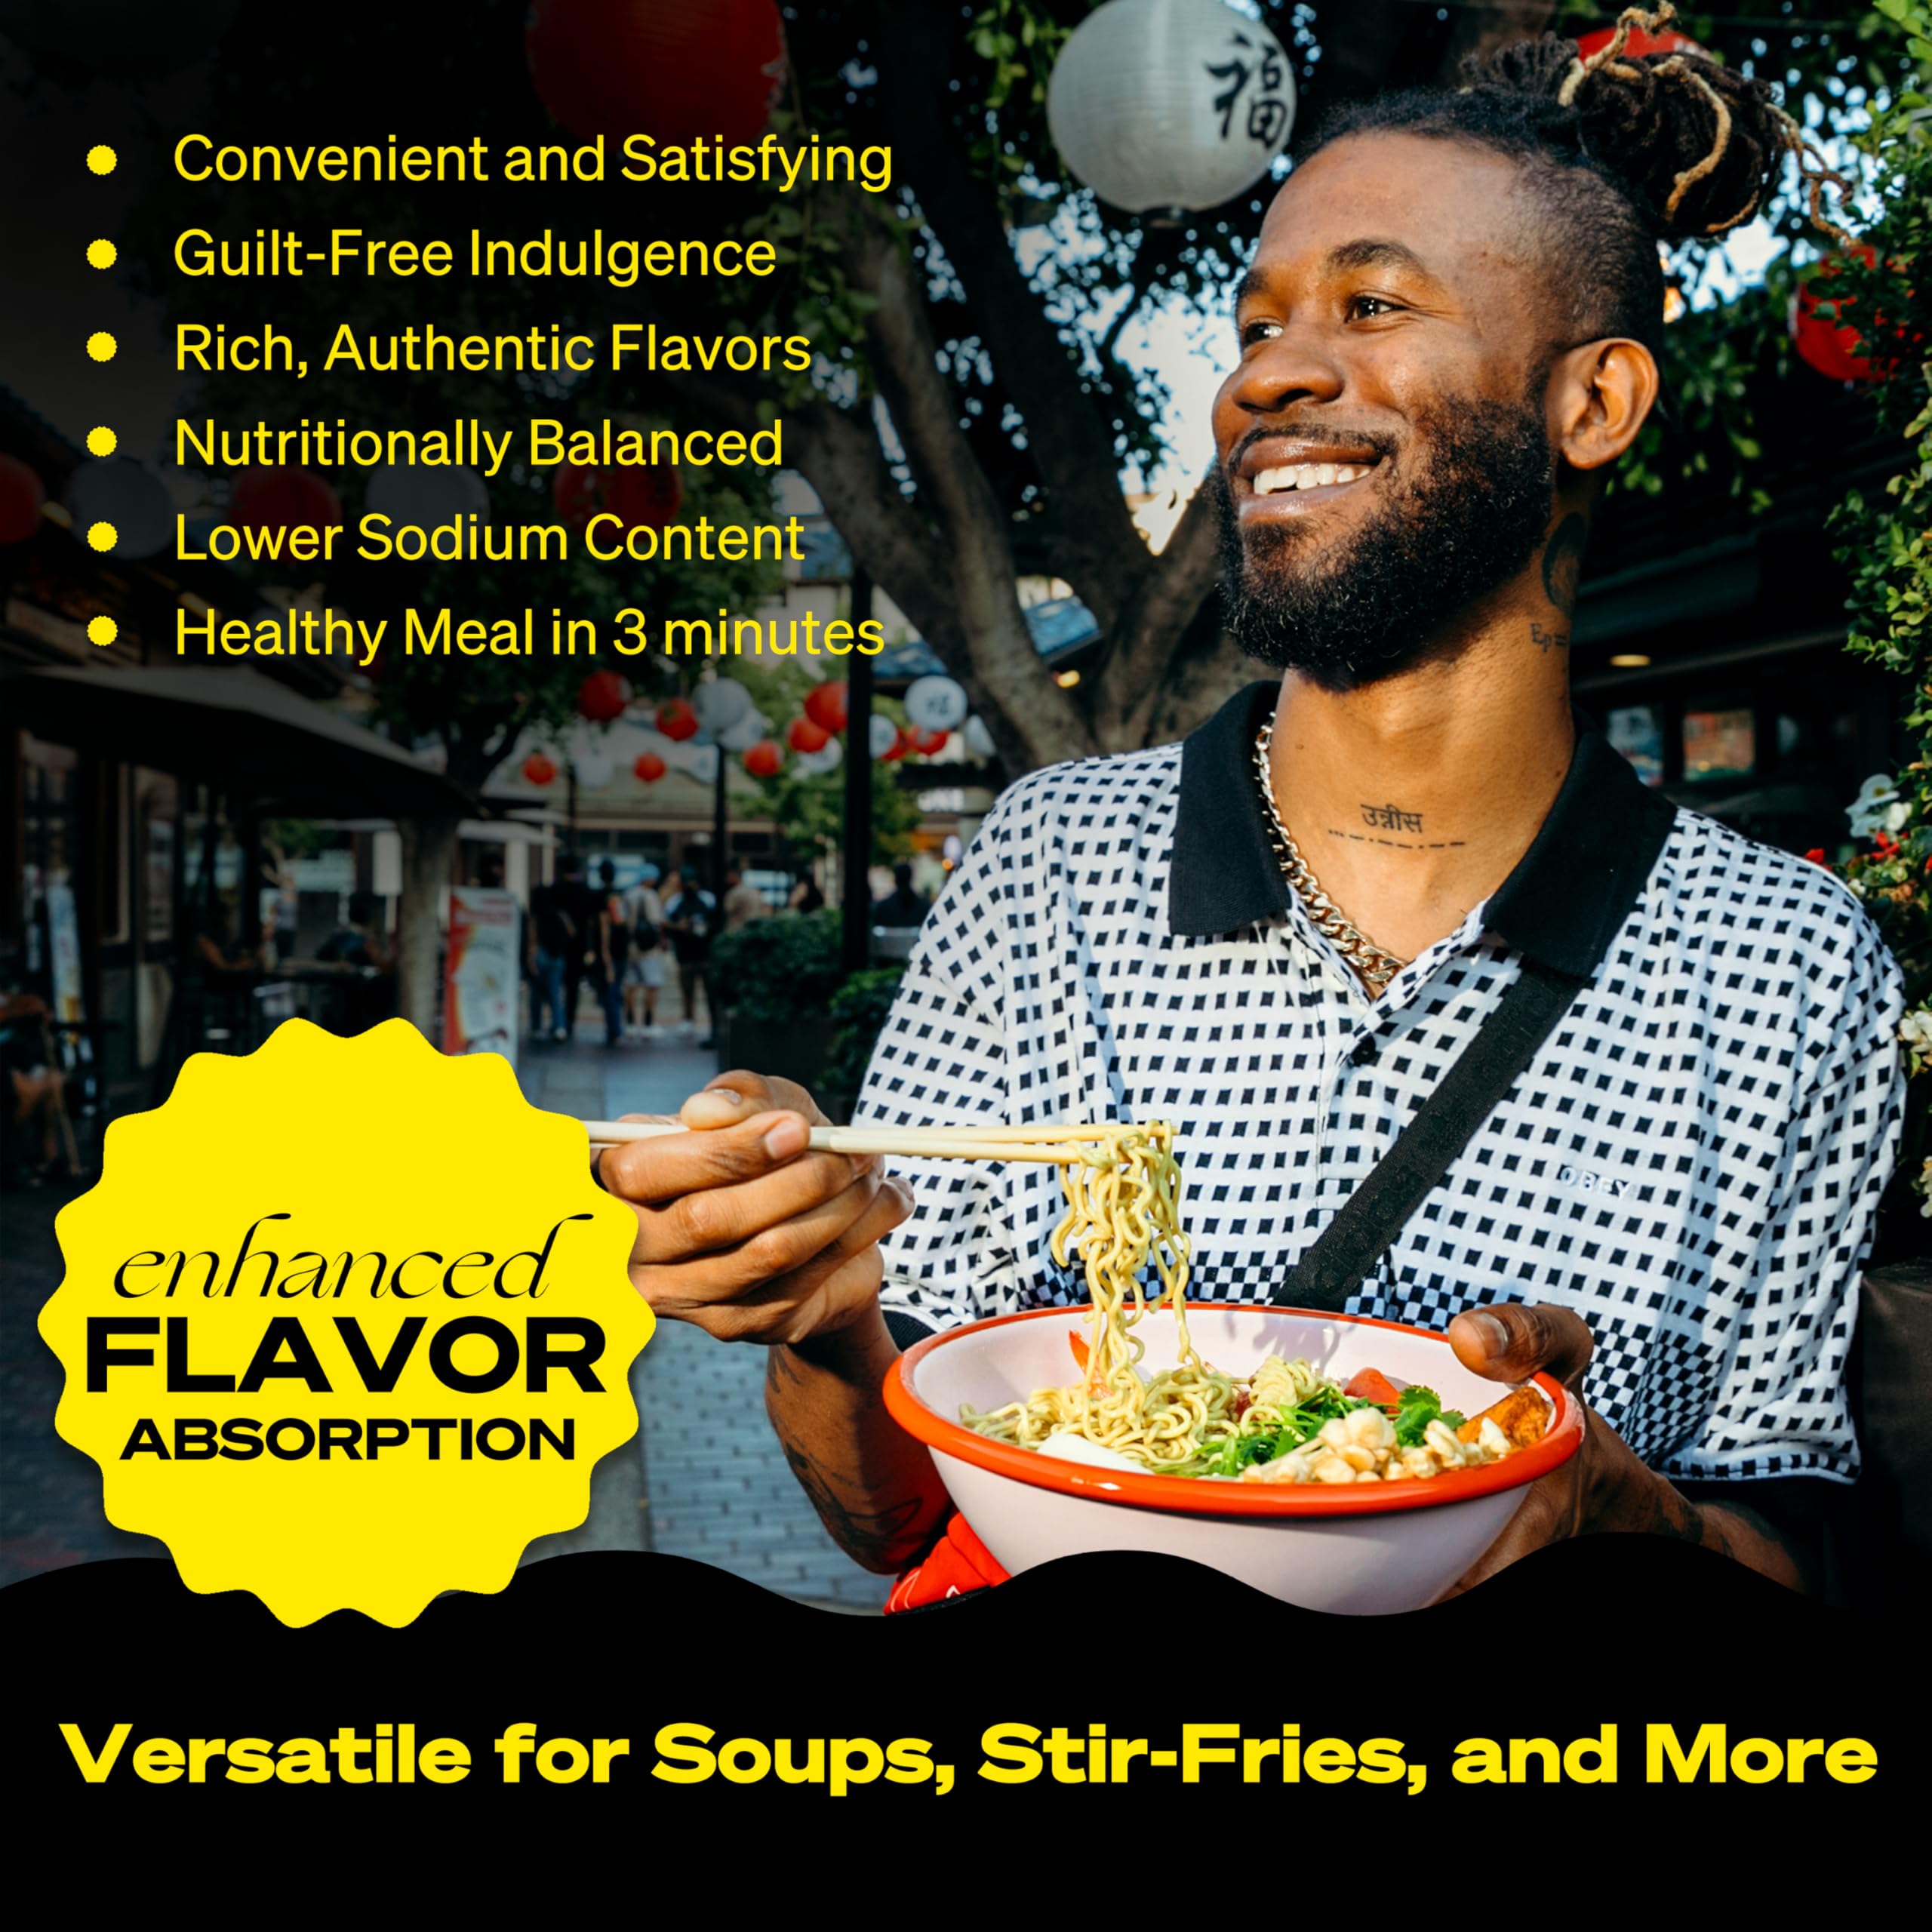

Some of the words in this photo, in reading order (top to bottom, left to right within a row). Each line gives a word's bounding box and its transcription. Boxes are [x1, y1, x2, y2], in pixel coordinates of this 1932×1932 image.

[1205, 31, 1288, 149] 福
[1360, 804, 1423, 833] उन्नीस
[1560, 1167, 1630, 1200] OBEY
